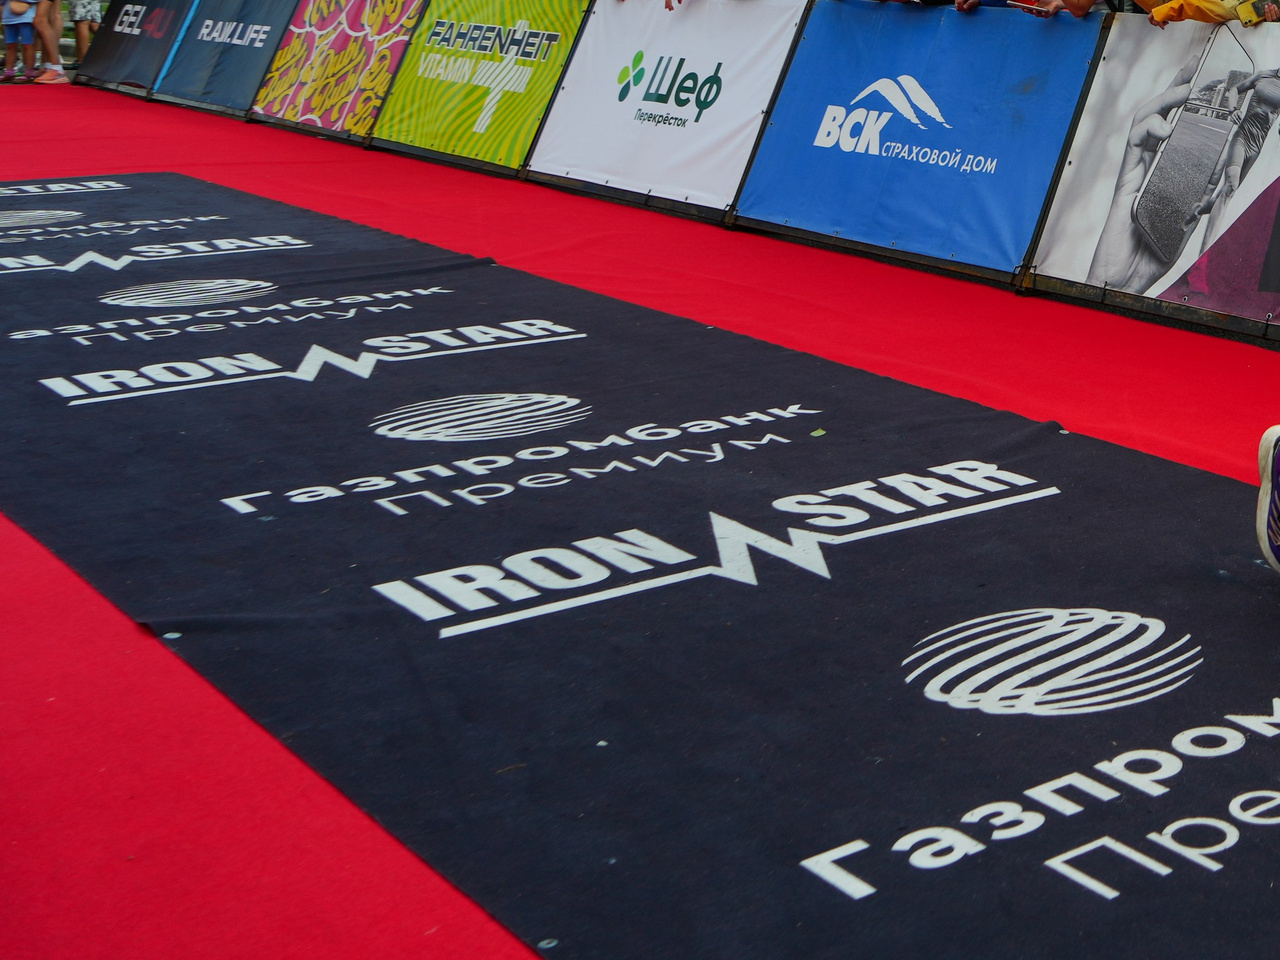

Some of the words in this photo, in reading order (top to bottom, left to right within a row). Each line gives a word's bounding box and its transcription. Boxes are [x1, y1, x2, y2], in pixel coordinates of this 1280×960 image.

[113, 4, 175, 39] GEL4U
[425, 19, 561, 61] FAHRENHEIT
[417, 52, 477, 83] VITAMIN
[643, 55, 723, 123] Шеф
[634, 107, 689, 128] Перекрёсток
[813, 104, 893, 156] ВСК
[881, 141, 961, 171] СТРАХОВОЙ
[959, 153, 998, 175] ДОМ
[130, 234, 307, 257] STAR
[71, 302, 413, 345] Премиум
[38, 352, 283, 398] IRON
[362, 318, 577, 355] STAR
[220, 403, 822, 514] Газпромбанк
[374, 429, 791, 515] Премиум
[372, 527, 697, 621] IRON
[772, 459, 1039, 527] STAR
